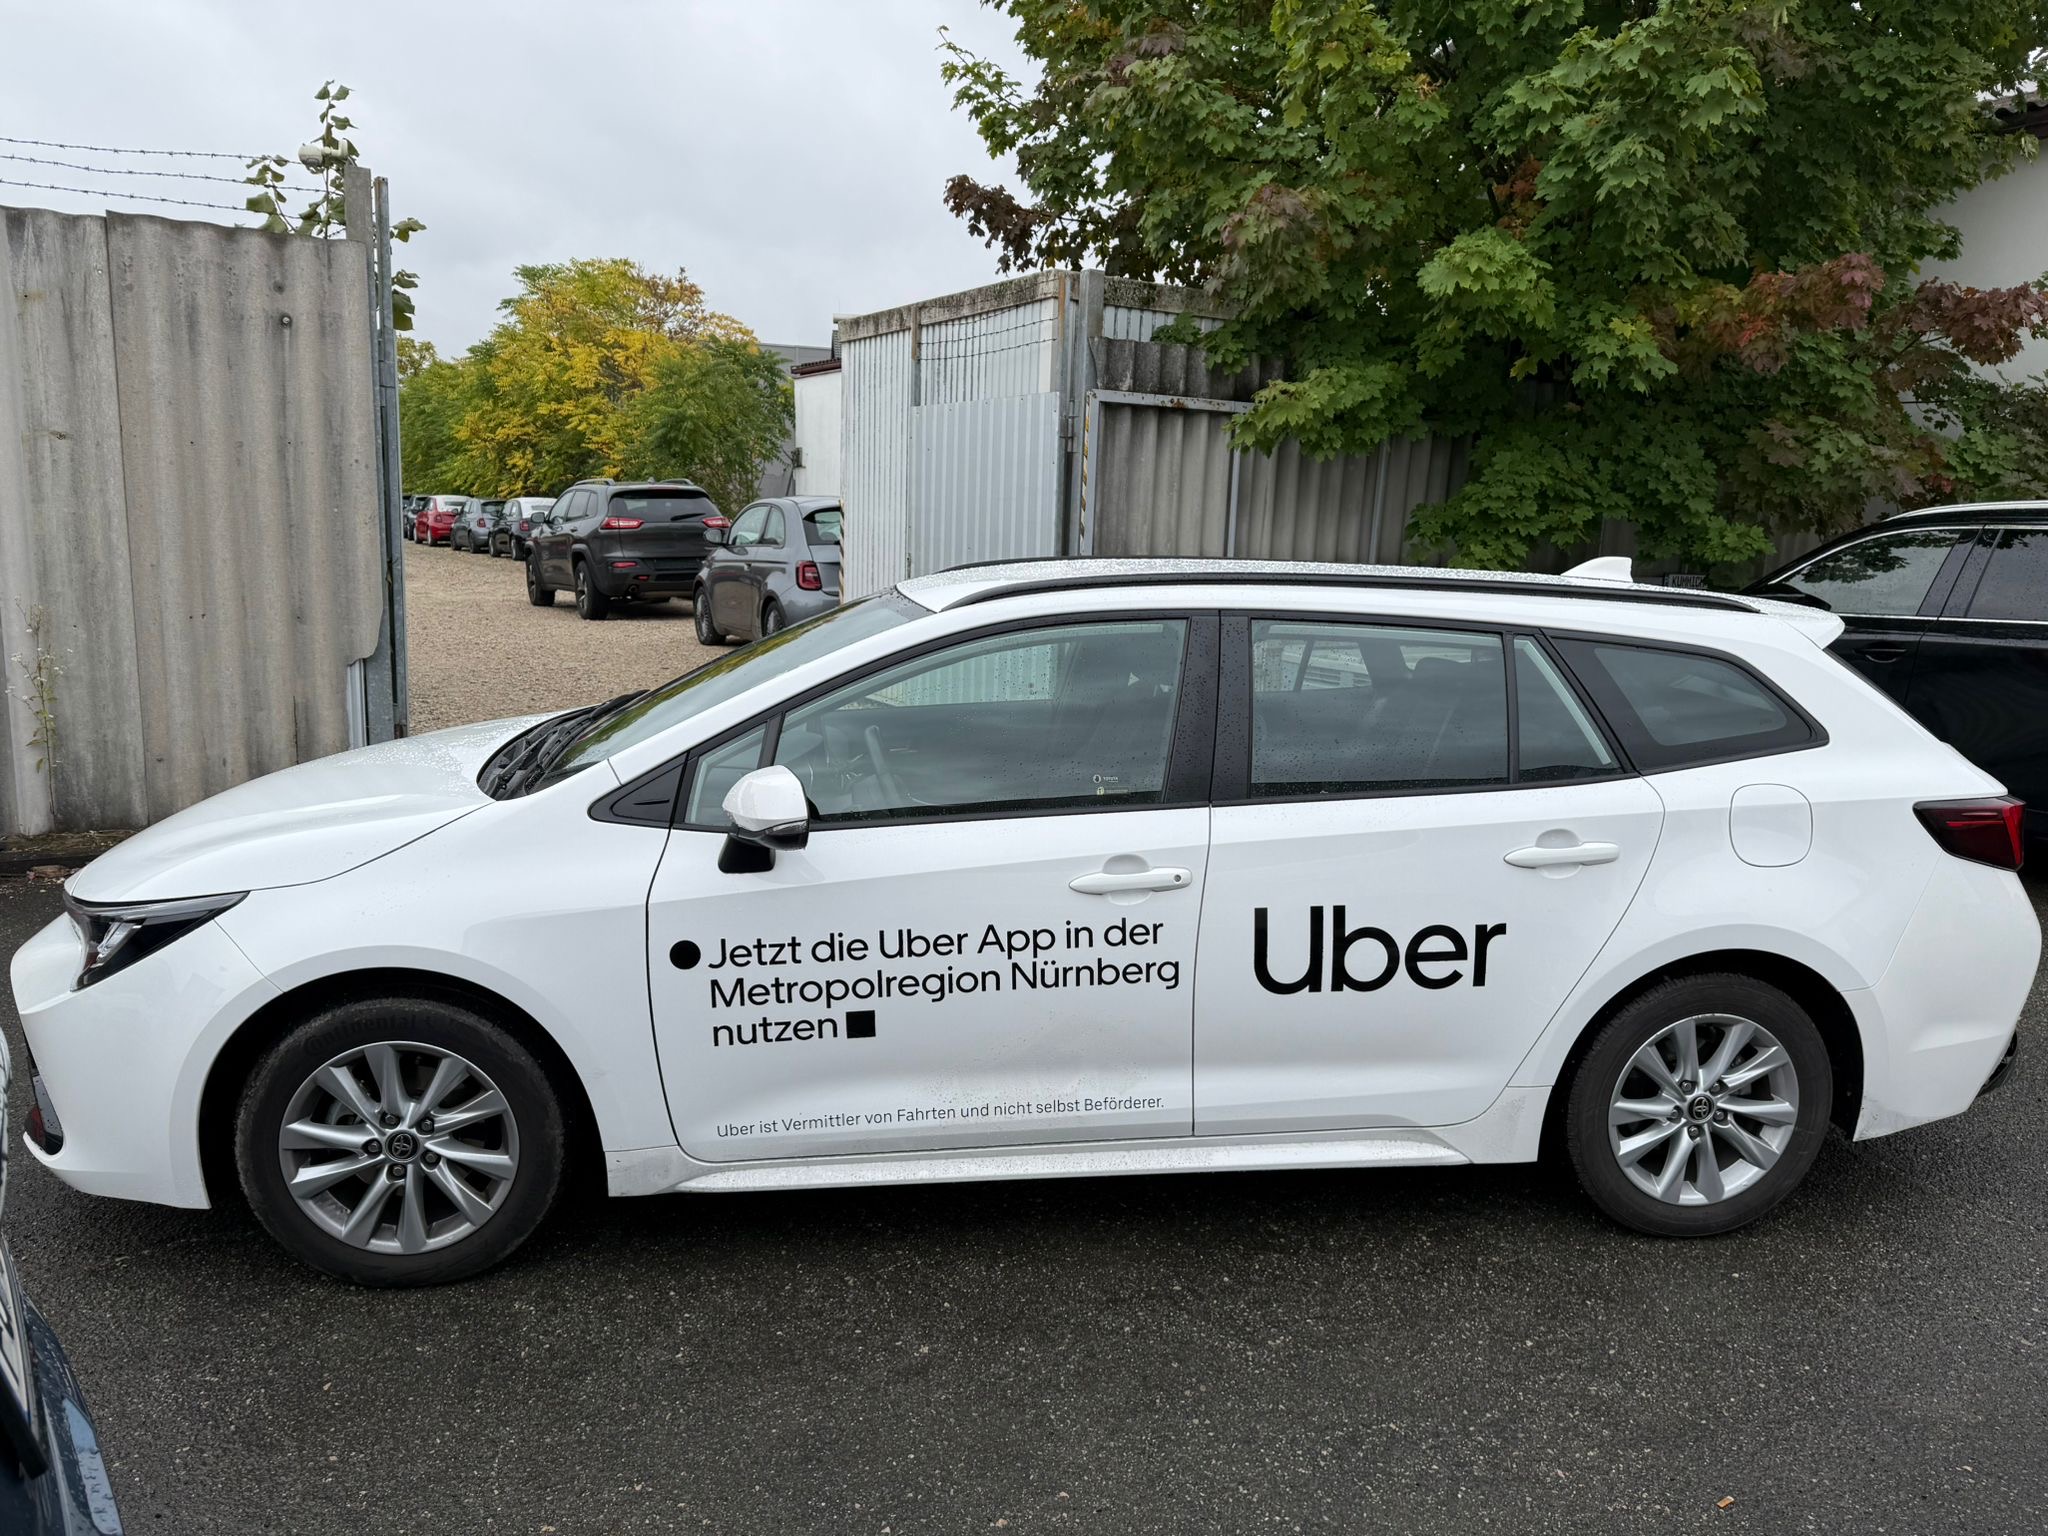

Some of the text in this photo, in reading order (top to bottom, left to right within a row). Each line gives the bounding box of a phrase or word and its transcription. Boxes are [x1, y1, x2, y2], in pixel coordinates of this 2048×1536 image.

[708, 918, 1163, 968] Jetzt die Uber App in der
[1254, 905, 1506, 995] Uber
[711, 958, 1179, 1008] Metropolregion Nürnberg
[713, 1016, 837, 1046] nutzen
[717, 1096, 1164, 1137] Uber ist Vermittler von Fahrten und nicht selbst Beförderer.
